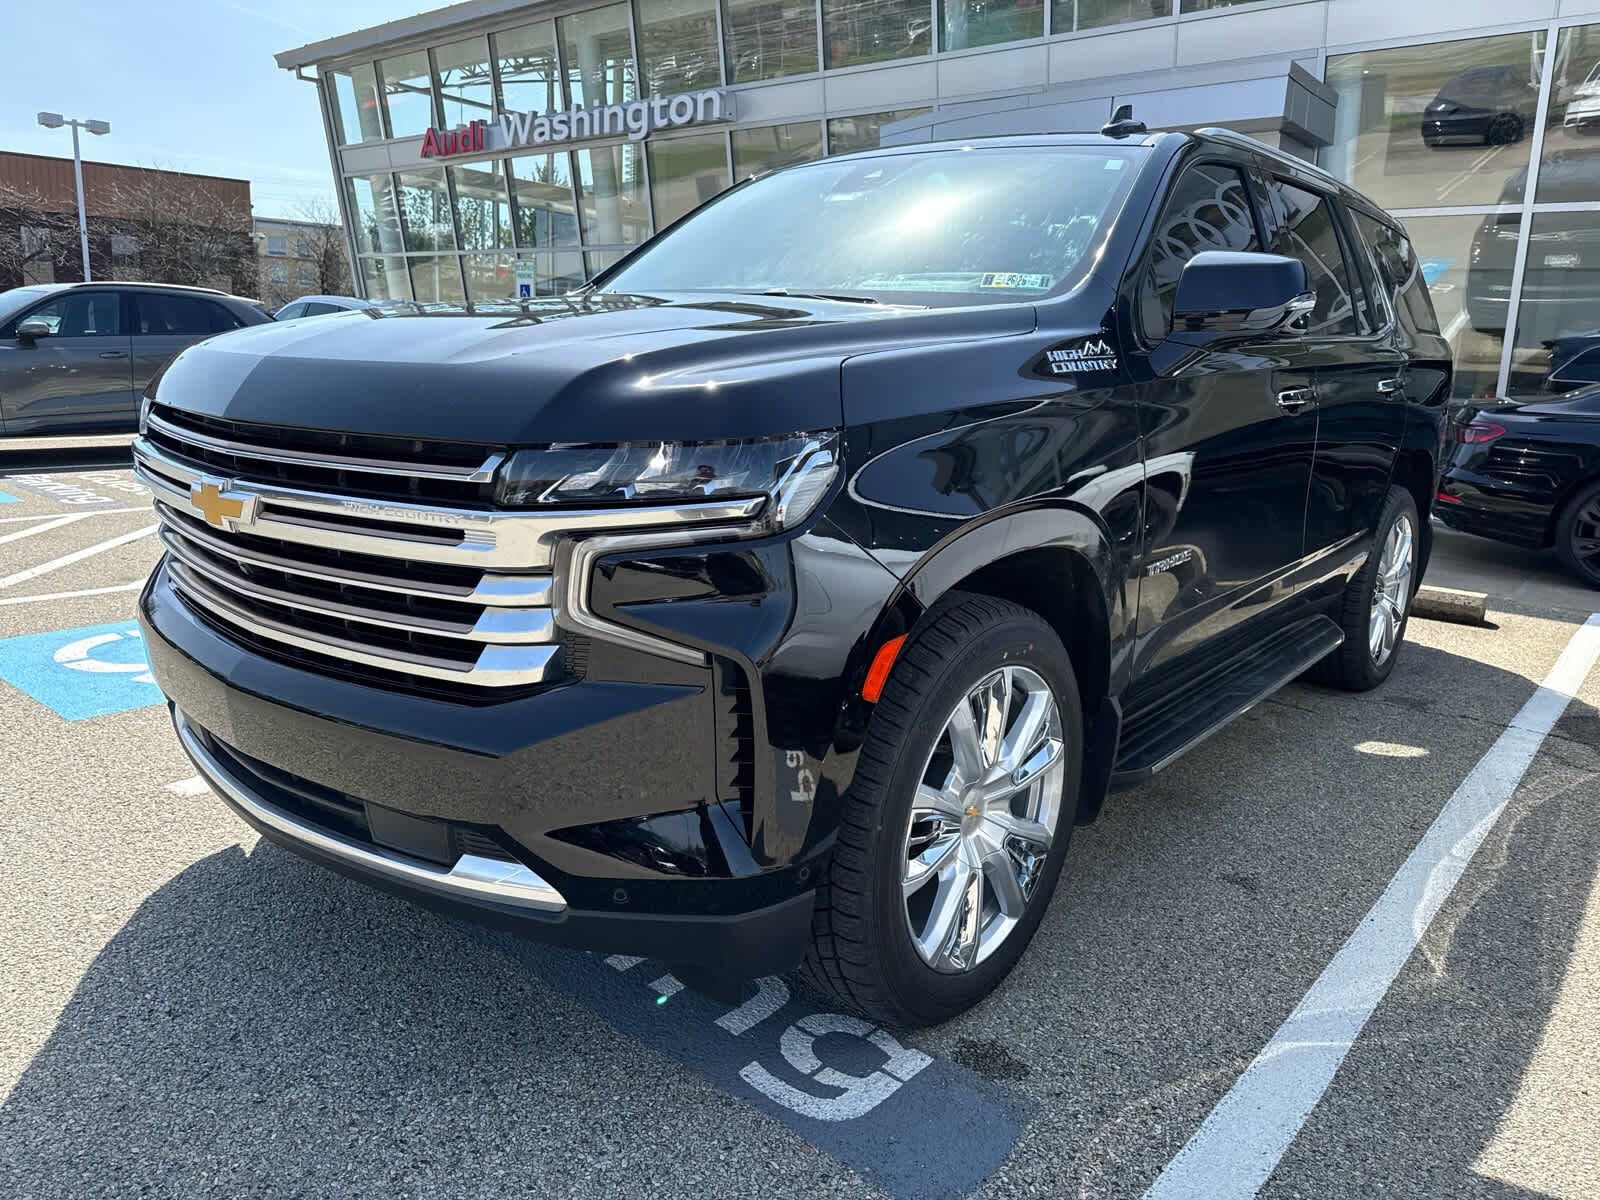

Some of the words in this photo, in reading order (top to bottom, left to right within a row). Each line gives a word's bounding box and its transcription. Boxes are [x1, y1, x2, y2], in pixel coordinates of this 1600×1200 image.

[420, 119, 486, 158] Audi
[499, 88, 721, 140] Washington
[1046, 349, 1084, 362] HIGH
[1051, 358, 1117, 373] COUNTRY
[384, 505, 463, 524] COUNTRY
[1146, 548, 1192, 577] TAHOE
